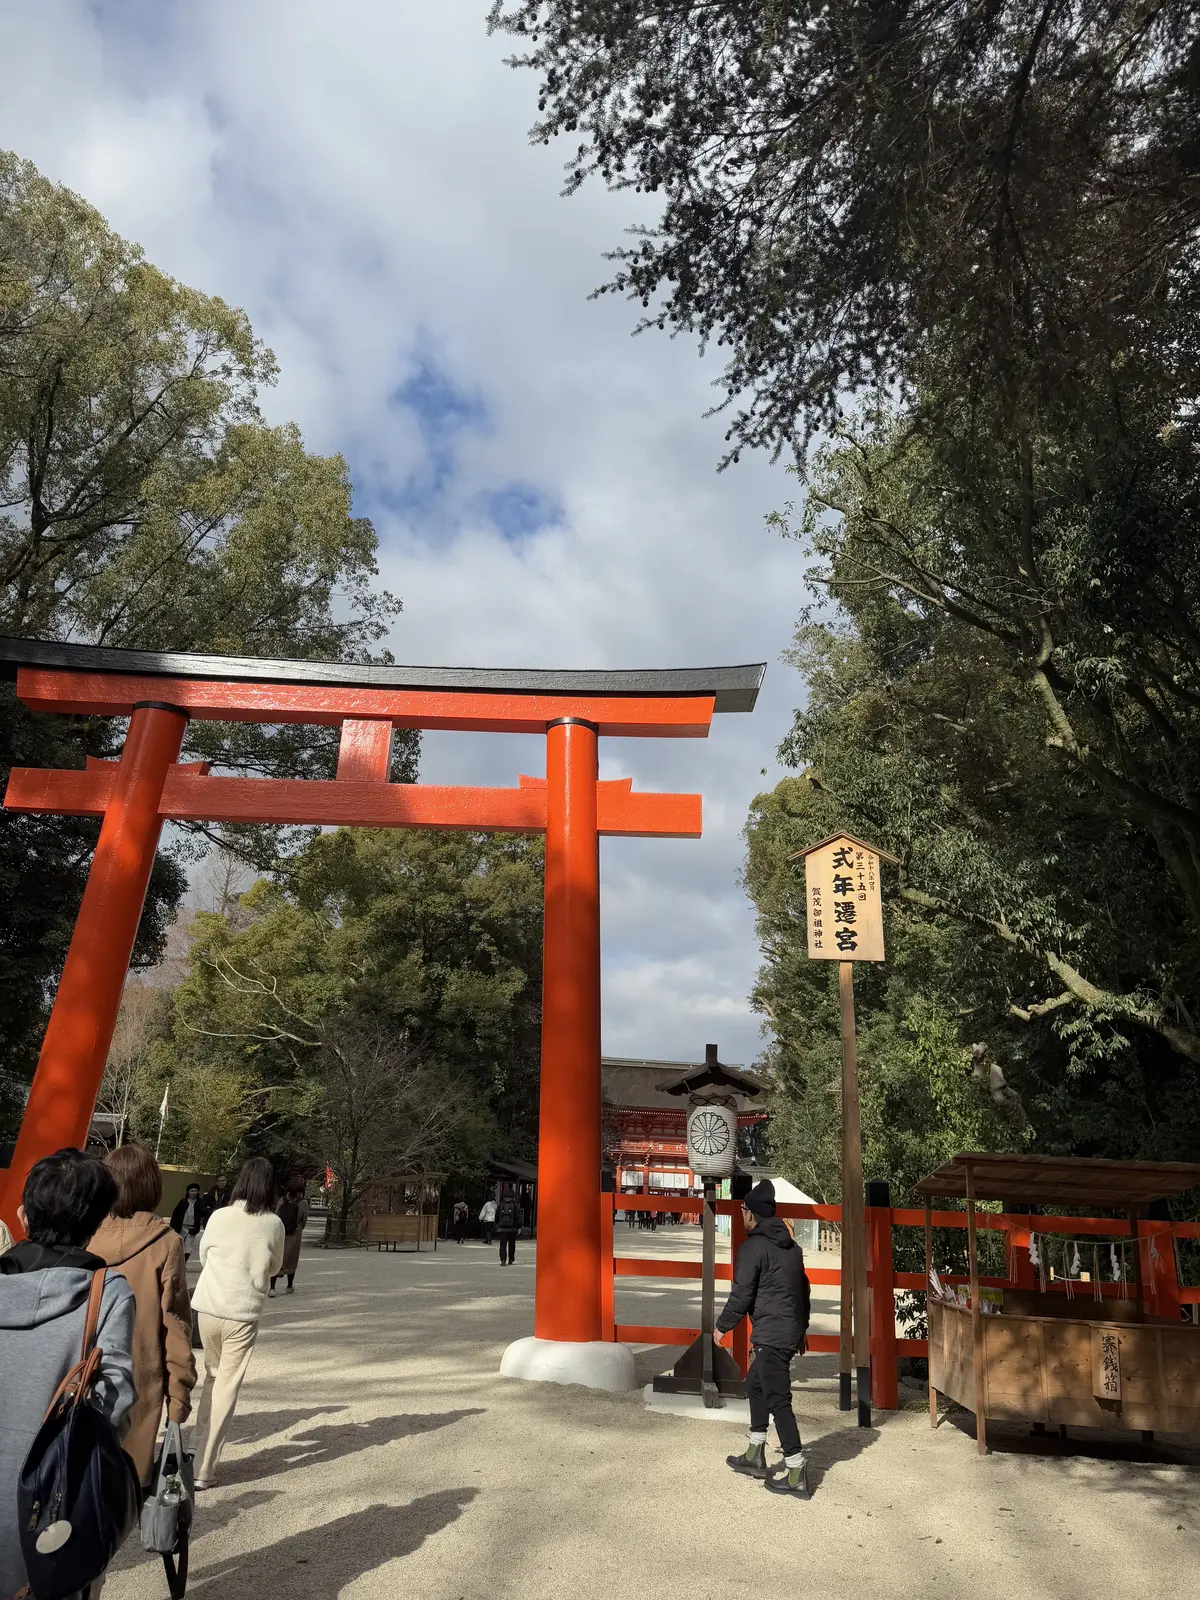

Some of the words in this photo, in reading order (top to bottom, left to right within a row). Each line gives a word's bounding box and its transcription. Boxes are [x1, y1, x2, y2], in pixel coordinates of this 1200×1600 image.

[832, 847, 858, 952] 式年遷宮
[856, 851, 867, 901] 第三十五回
[812, 887, 824, 949] 賀茂御祖神社
[1102, 1333, 1119, 1394] 賽銭箱
